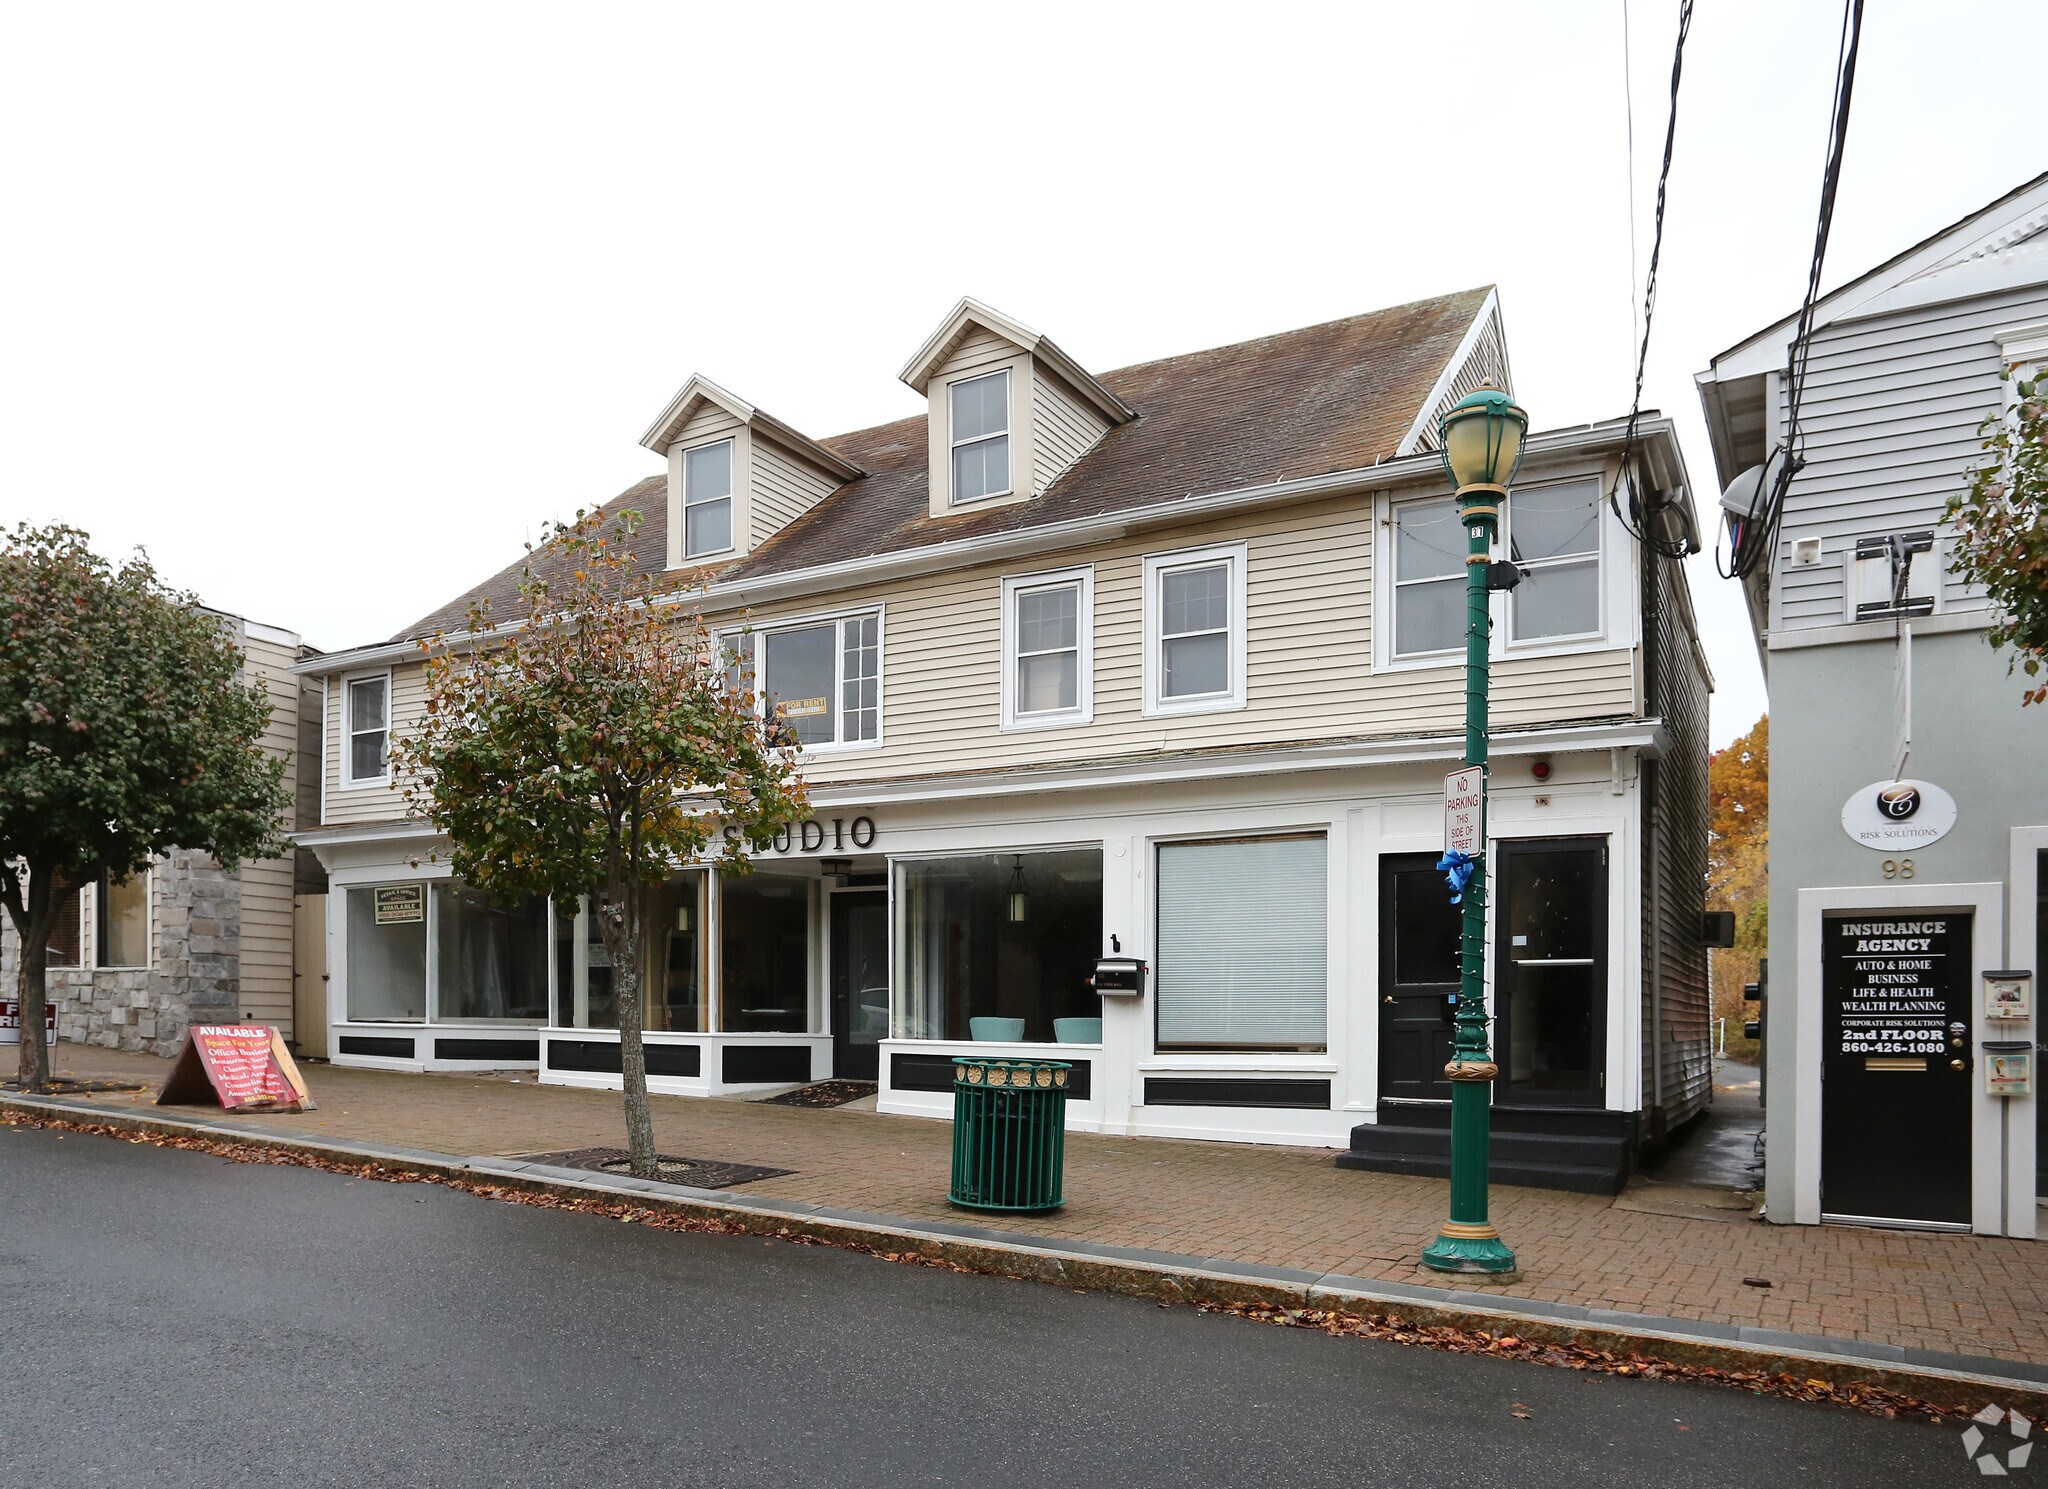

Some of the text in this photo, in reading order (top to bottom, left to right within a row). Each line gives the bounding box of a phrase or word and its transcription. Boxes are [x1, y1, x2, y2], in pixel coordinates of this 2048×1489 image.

[786, 699, 824, 709] FOR RENT
[1457, 779, 1468, 793] NO
[1447, 794, 1478, 812] PARKING
[1456, 813, 1468, 825] THIS
[1451, 825, 1473, 838] SIDE OF
[1860, 831, 1880, 840] RISK
[1884, 828, 1937, 838] SOLUTIONS
[1451, 838, 1472, 850] STREET
[1882, 859, 1915, 880] 98
[381, 890, 396, 899] RETAIL
[400, 889, 416, 897] OFFICE
[382, 903, 416, 911] AVAILABLE
[1842, 922, 1946, 936] INSURANCE
[1856, 939, 1931, 952] AGENCY
[1855, 960, 1932, 971] AUTO & HOME
[1868, 974, 1918, 984] BUSINESS
[1853, 988, 1934, 997] LIFE & HEALTH
[1842, 1001, 1945, 1011] WEALTH PLANNING
[0, 1016, 53, 1028] RET
[1904, 1019, 1945, 1027] SOLUTIONS
[200, 1026, 267, 1038] AVAILABLE
[1843, 1029, 1944, 1040] 2nd FLOOR
[205, 1038, 270, 1048] Space For Your
[1842, 1042, 1945, 1053] 860-426-1080
[208, 1049, 239, 1057] Office,
[217, 1073, 250, 1081] Medical,
[228, 1089, 254, 1097] Annex,
